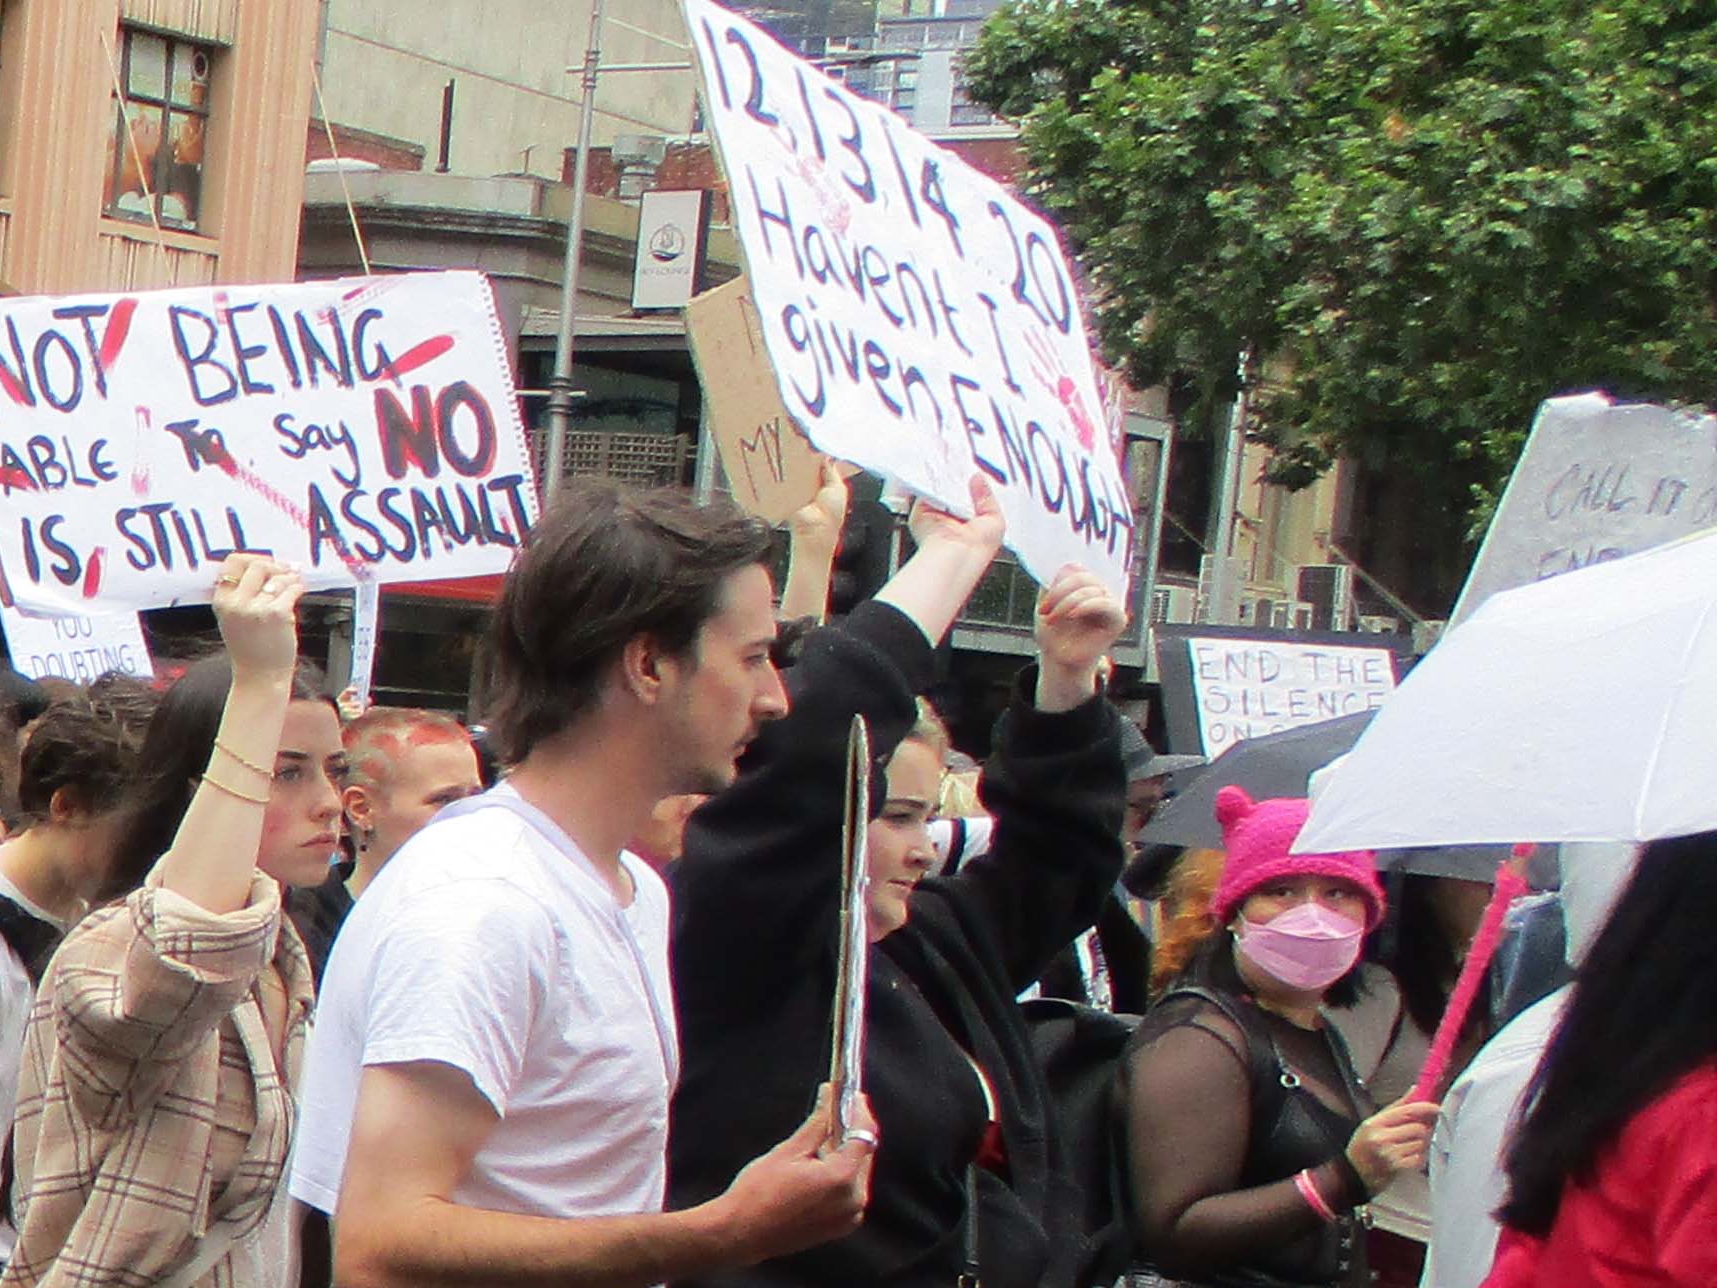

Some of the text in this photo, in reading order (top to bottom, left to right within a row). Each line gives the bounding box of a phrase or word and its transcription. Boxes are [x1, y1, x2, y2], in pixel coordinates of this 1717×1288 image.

[169, 301, 387, 407] BEING
[781, 295, 944, 428] given
[0, 379, 499, 494] ABLE NO
[738, 416, 784, 502] MY
[22, 474, 538, 588] IS STILL ASSAULT
[1545, 462, 1640, 520] CALL
[1645, 477, 1689, 516] IT
[1198, 647, 1386, 687] END THE
